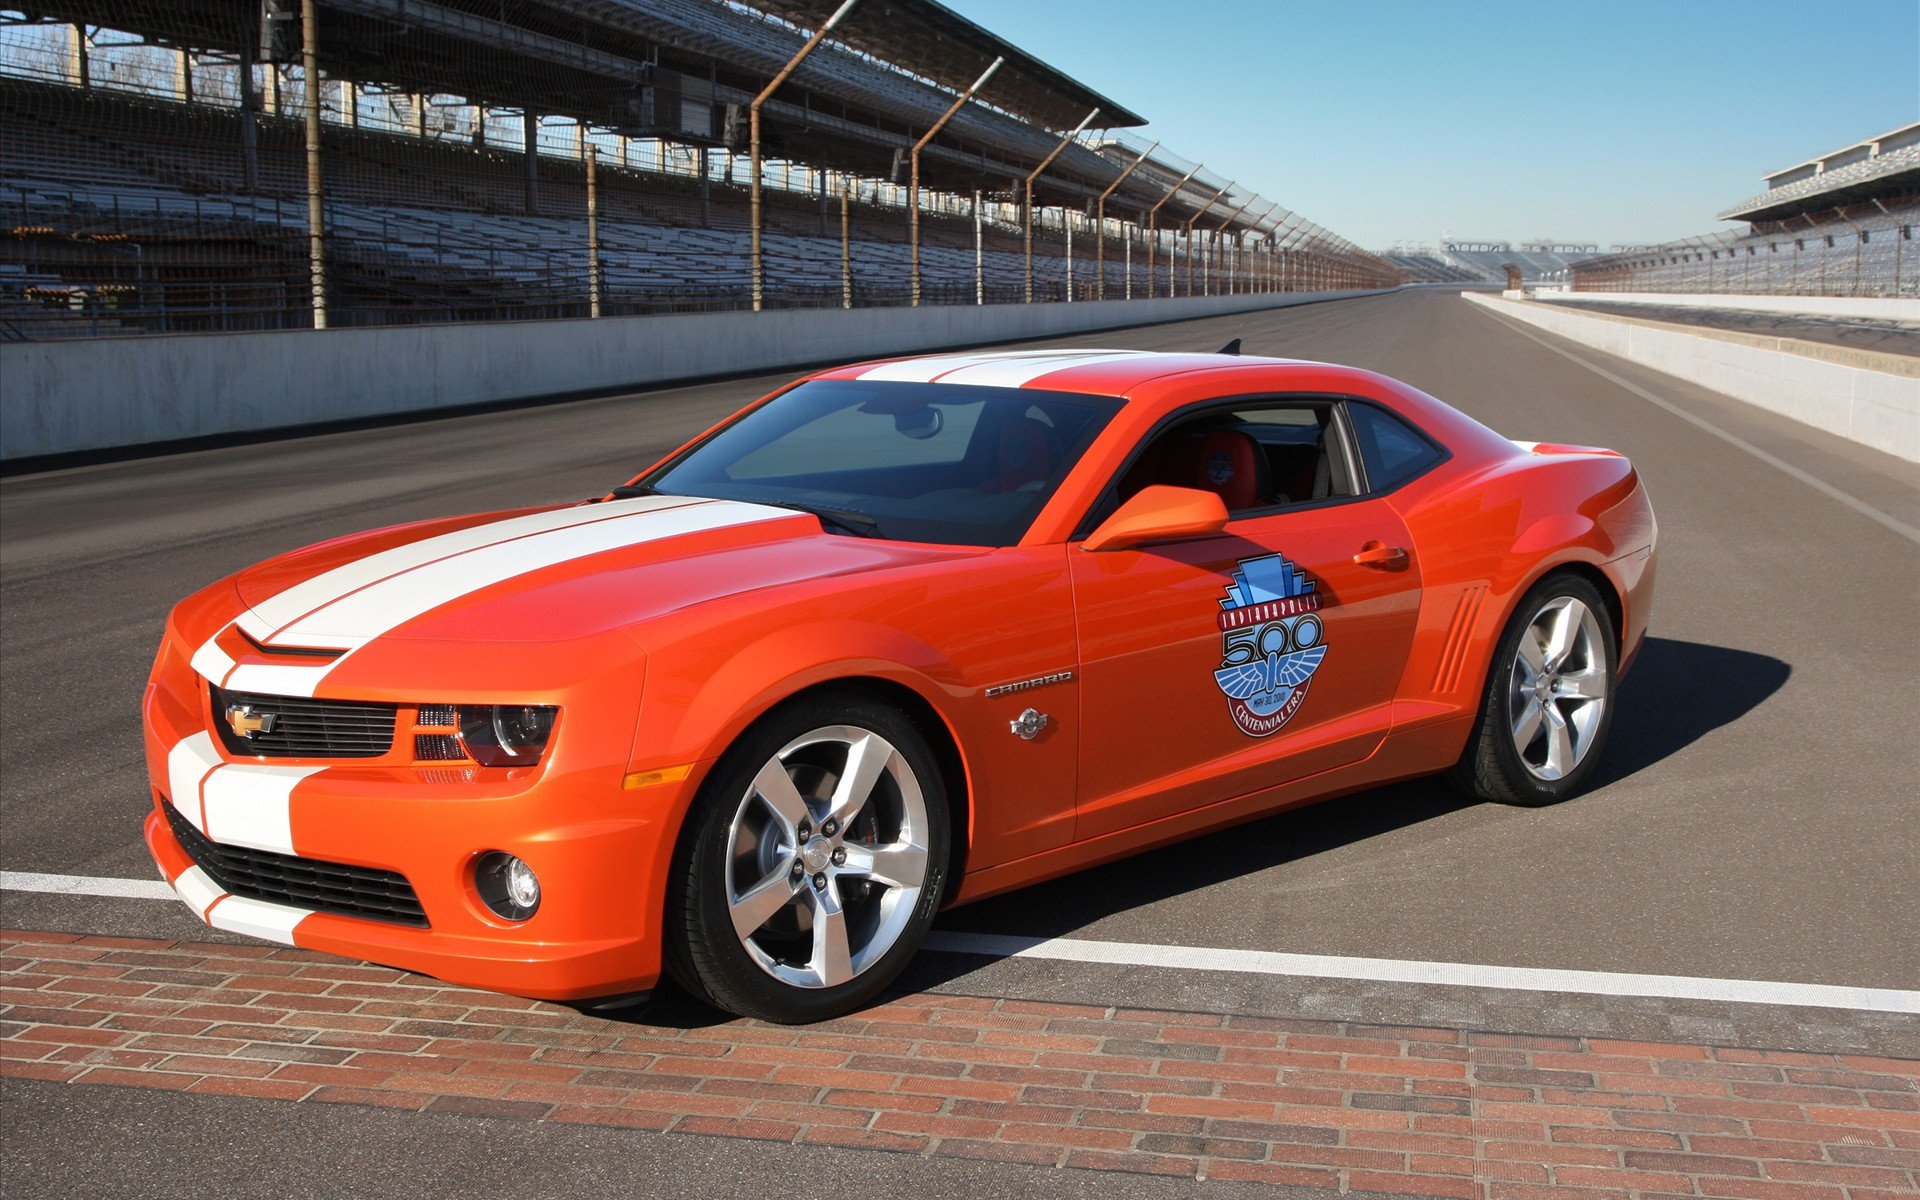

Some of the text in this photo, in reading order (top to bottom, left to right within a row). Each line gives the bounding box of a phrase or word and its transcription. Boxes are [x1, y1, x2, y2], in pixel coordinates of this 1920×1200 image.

[1222, 595, 1318, 629] INDIANAPOLIS
[1221, 613, 1324, 668] 500
[985, 671, 1072, 697] CAMARO
[1236, 690, 1303, 731] CENTENNIAL ERA
